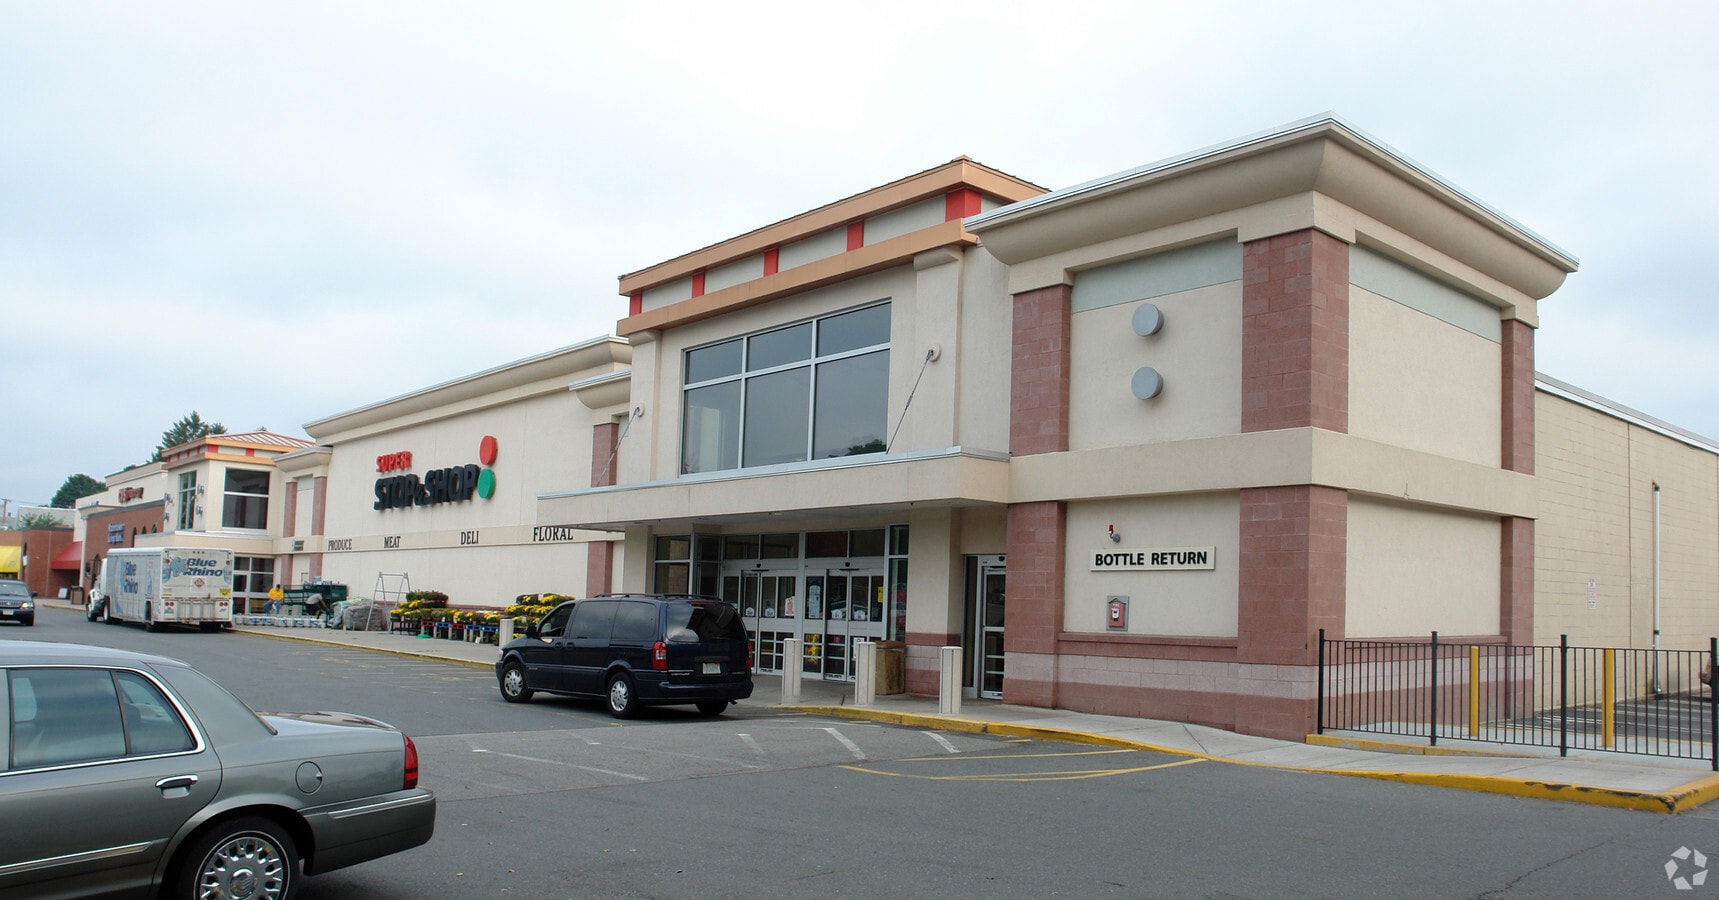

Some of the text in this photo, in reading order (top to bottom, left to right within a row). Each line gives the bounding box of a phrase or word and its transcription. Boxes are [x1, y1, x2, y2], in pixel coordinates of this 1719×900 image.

[376, 451, 412, 472] SUPER
[460, 531, 479, 545] DELI
[533, 526, 573, 542] FLORAL
[328, 539, 352, 551] PRODUCE
[383, 536, 401, 548] MEAT
[186, 558, 216, 567] Blue
[1095, 551, 1207, 566] BOTTLE RETURN
[183, 567, 223, 577] Rhino
